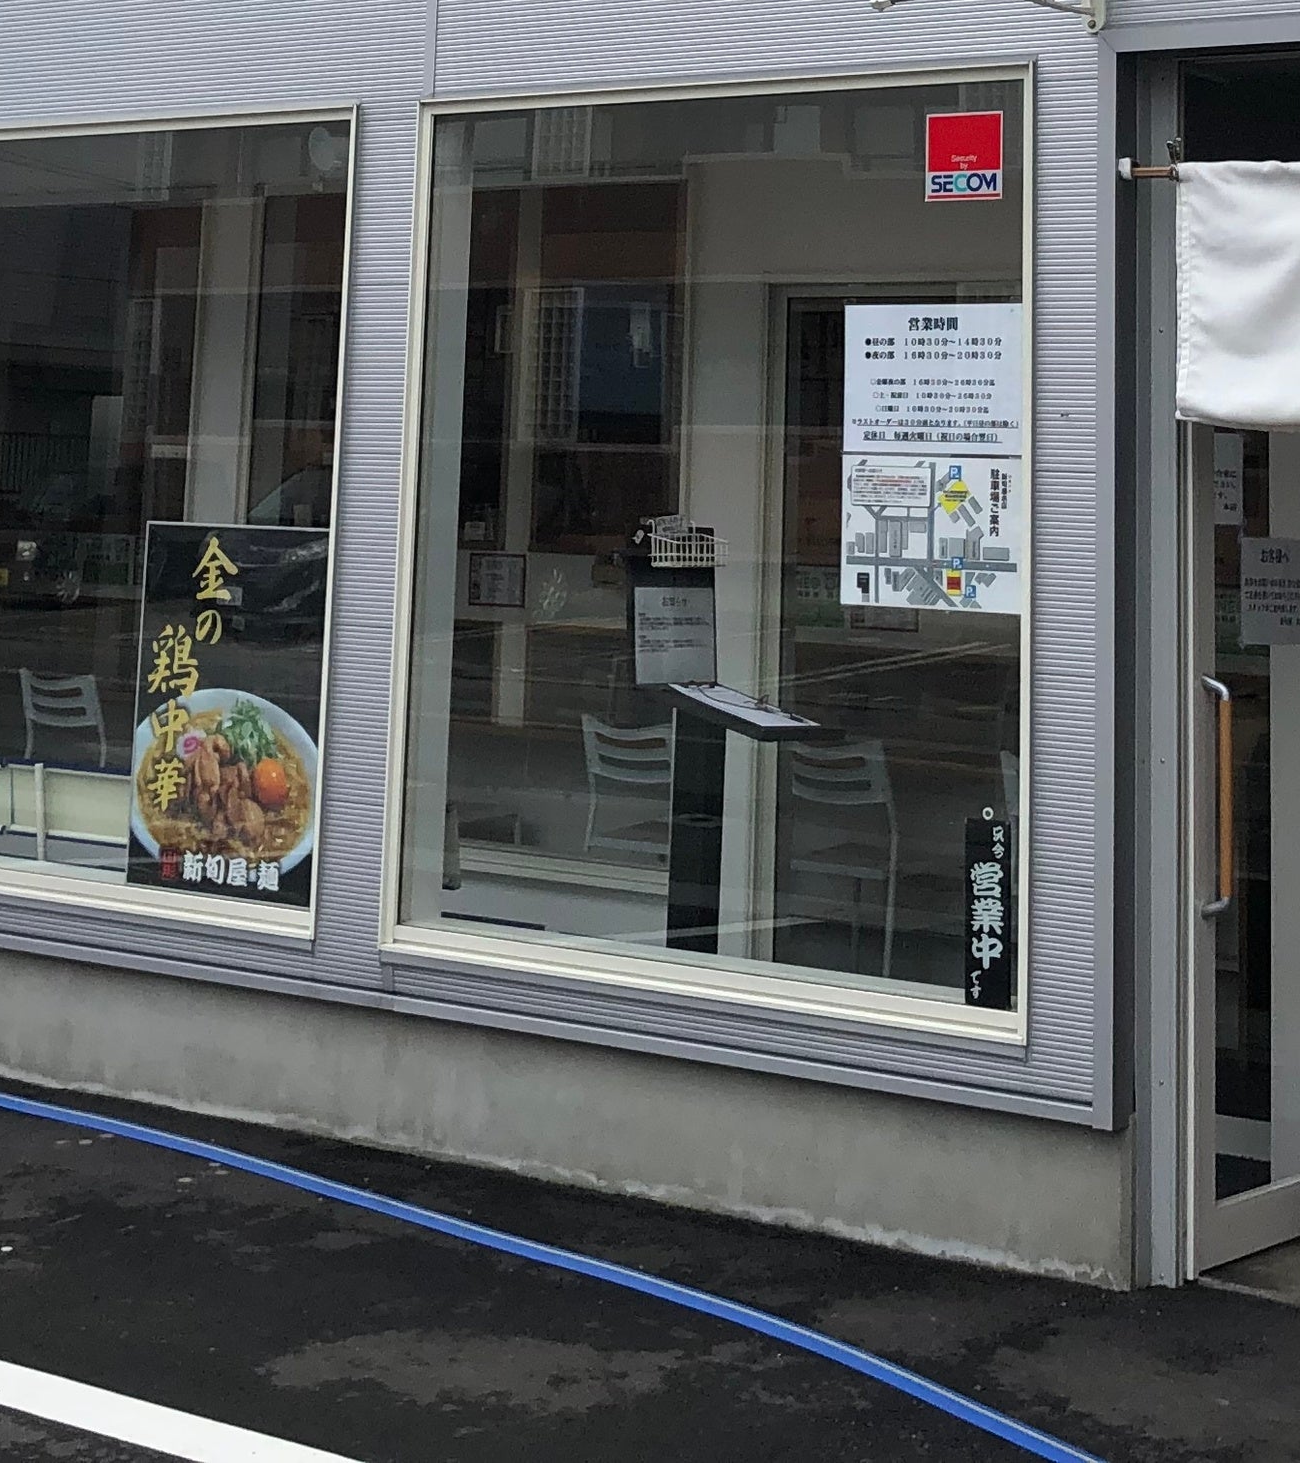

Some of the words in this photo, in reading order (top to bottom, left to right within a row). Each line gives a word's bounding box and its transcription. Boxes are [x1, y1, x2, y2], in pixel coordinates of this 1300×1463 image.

[931, 173, 997, 193] SECOM
[907, 317, 959, 331] 営業時間
[990, 469, 1000, 537] 駐車場ご案内
[192, 536, 239, 645] 金の
[147, 624, 200, 813] 鶏中華
[991, 825, 1005, 860] 只今
[182, 849, 248, 887] 新旬屋
[970, 861, 1004, 970] 営業中
[970, 970, 982, 1000] です
